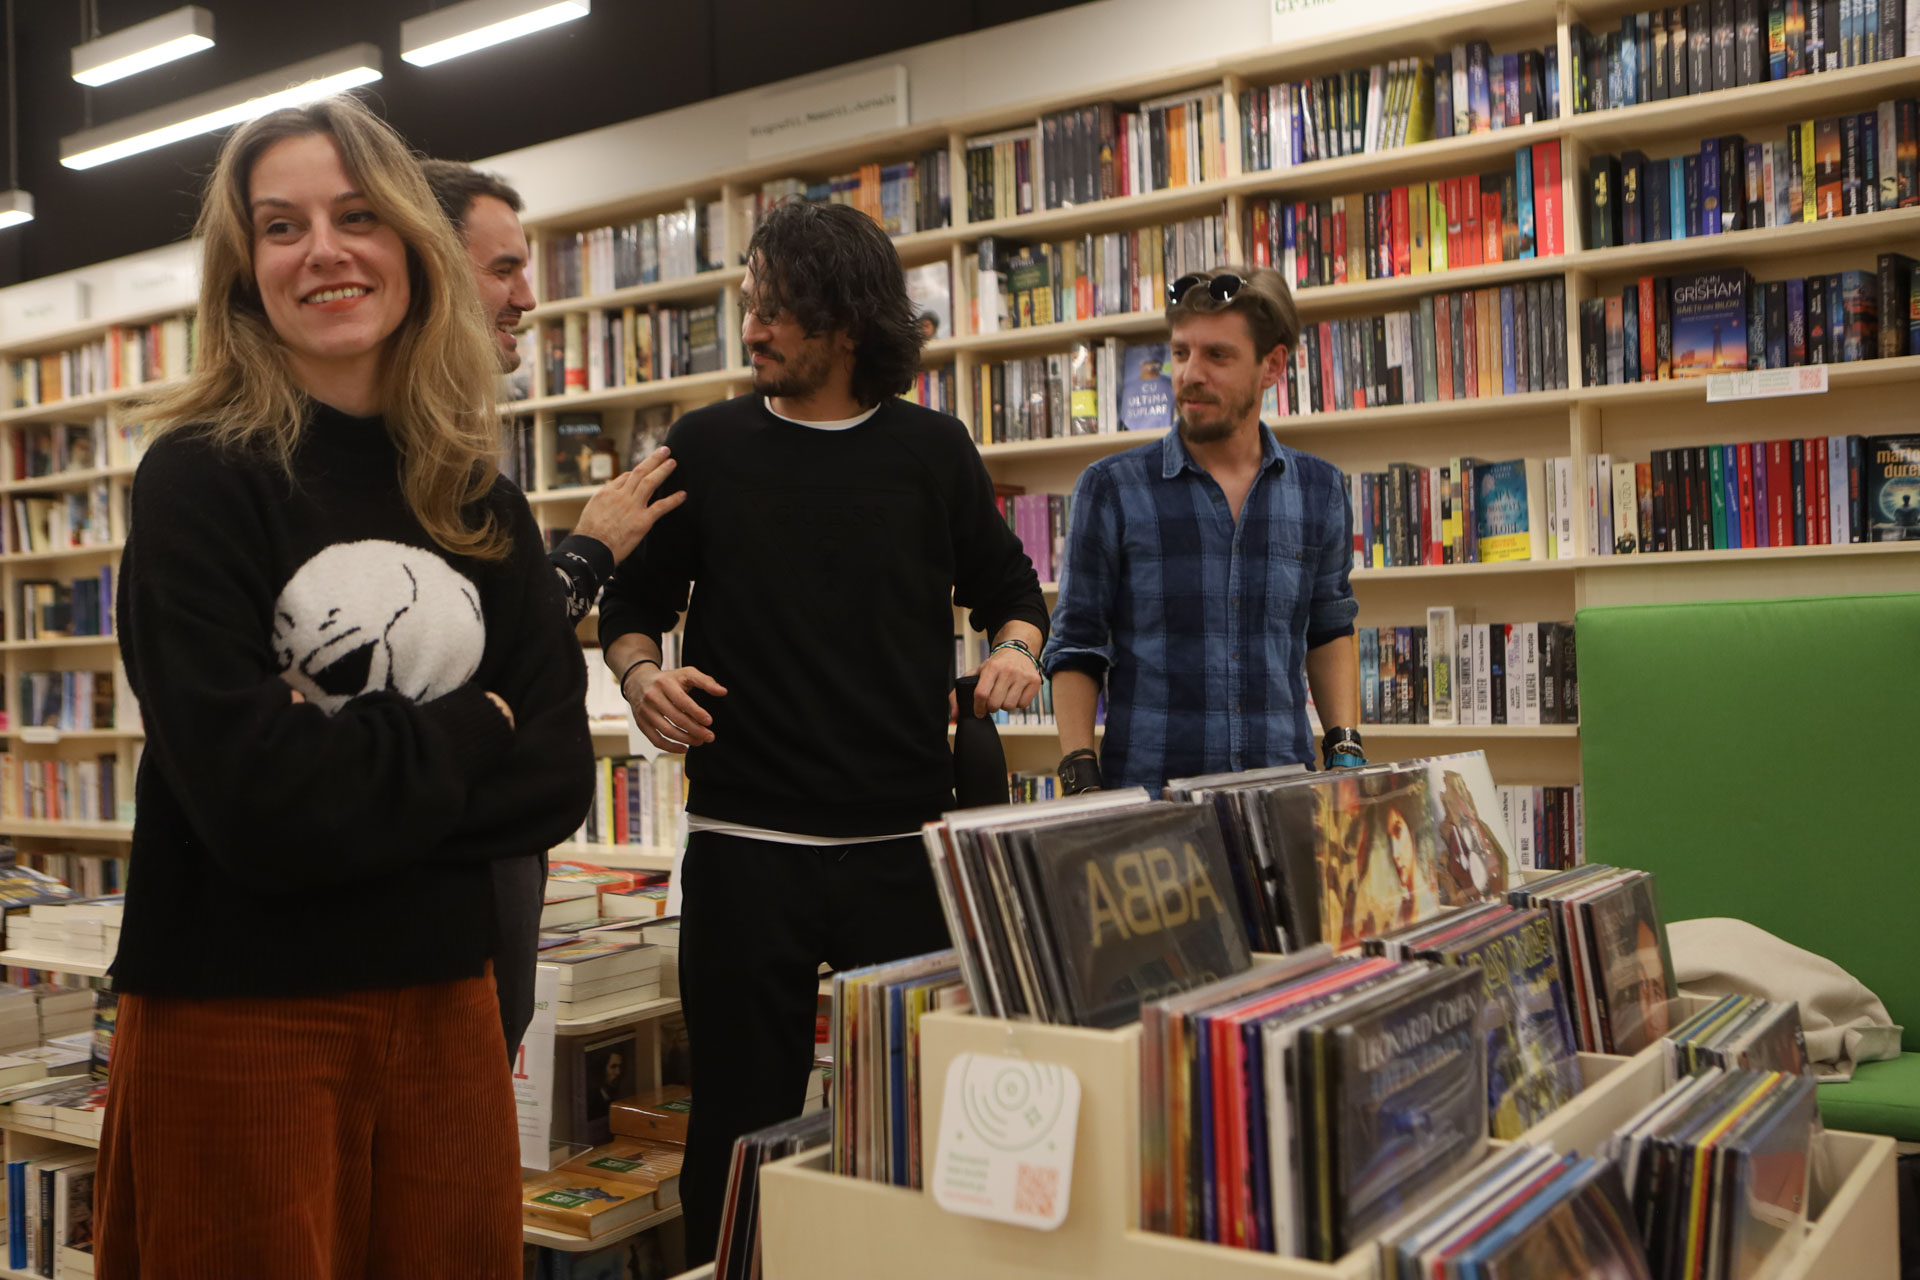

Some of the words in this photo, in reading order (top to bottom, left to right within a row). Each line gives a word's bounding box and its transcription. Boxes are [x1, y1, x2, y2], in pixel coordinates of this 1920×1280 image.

[1674, 280, 1742, 304] GRISHAM
[1476, 677, 1487, 703] HUNTER
[1086, 841, 1225, 948] ABBA
[1358, 1012, 1432, 1073] LEONARD
